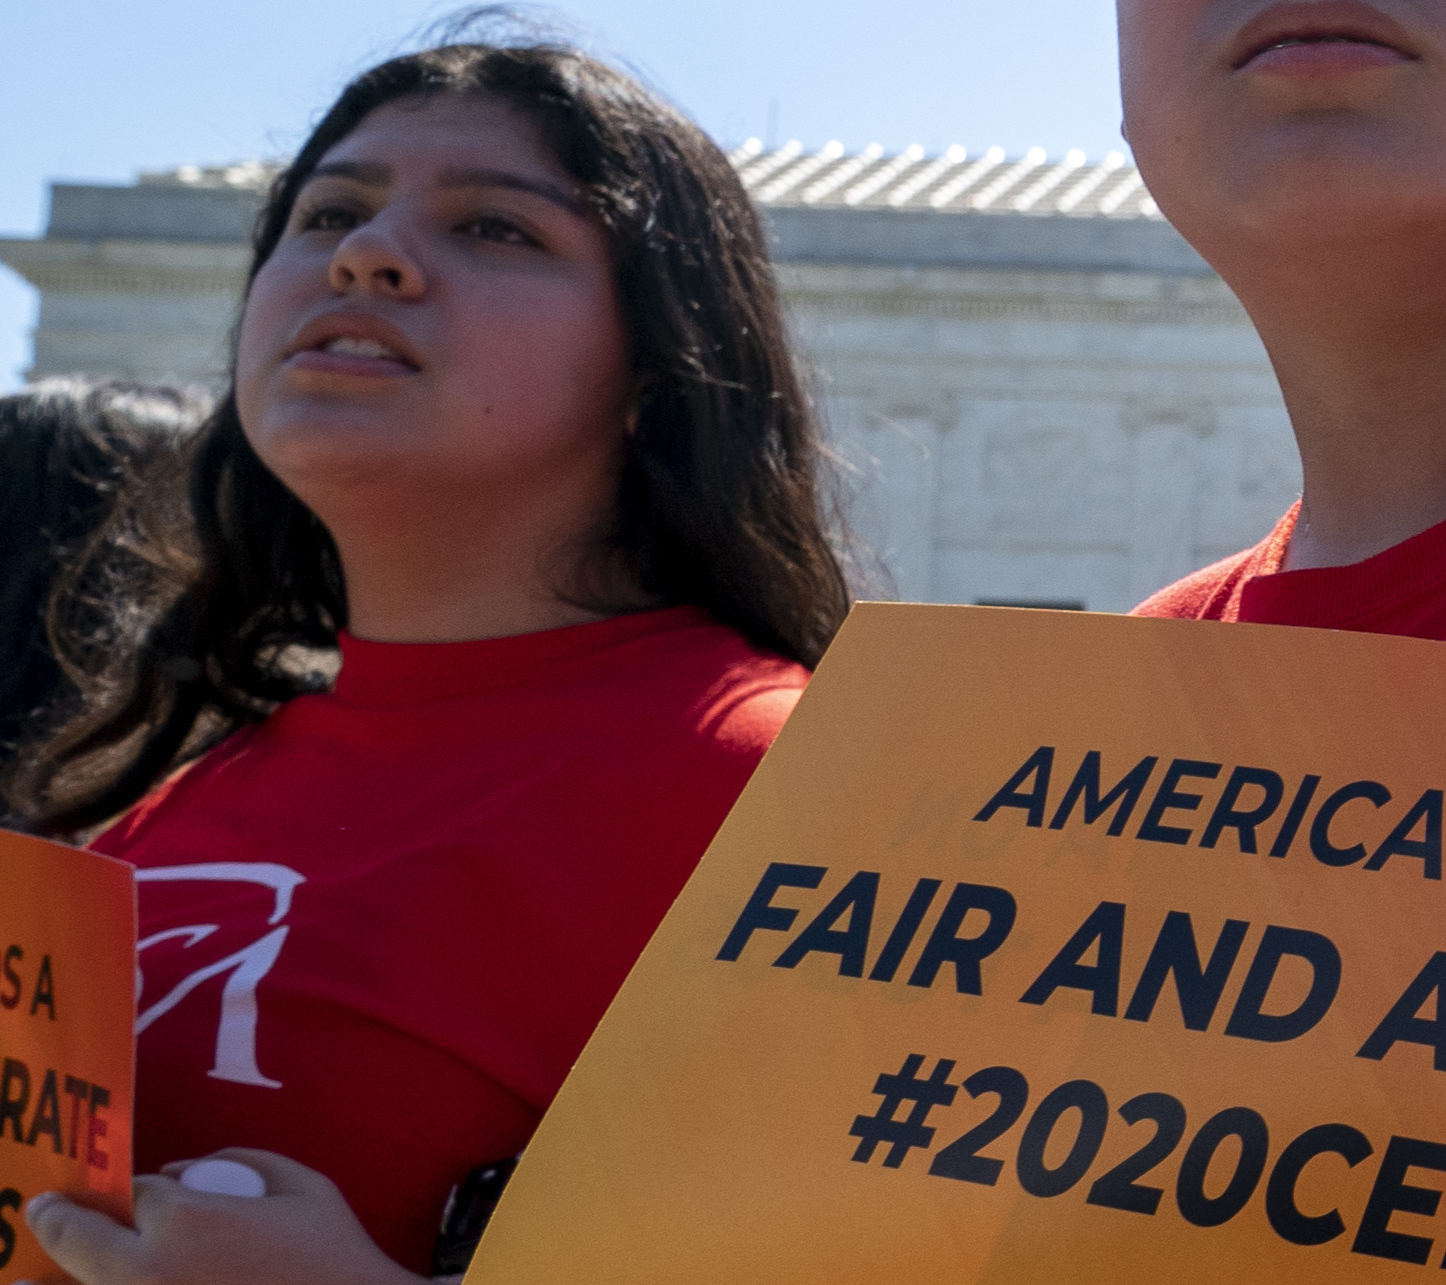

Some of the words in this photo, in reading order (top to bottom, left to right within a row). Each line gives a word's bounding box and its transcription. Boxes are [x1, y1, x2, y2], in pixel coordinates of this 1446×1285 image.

[972, 746, 1444, 881] AMERICA
[0, 944, 23, 1010] S
[30, 954, 56, 1021] A
[715, 862, 1017, 996] FAIR
[1019, 901, 1342, 1043] AND
[0, 1057, 111, 1171] RATE
[0, 1188, 22, 1275] S
